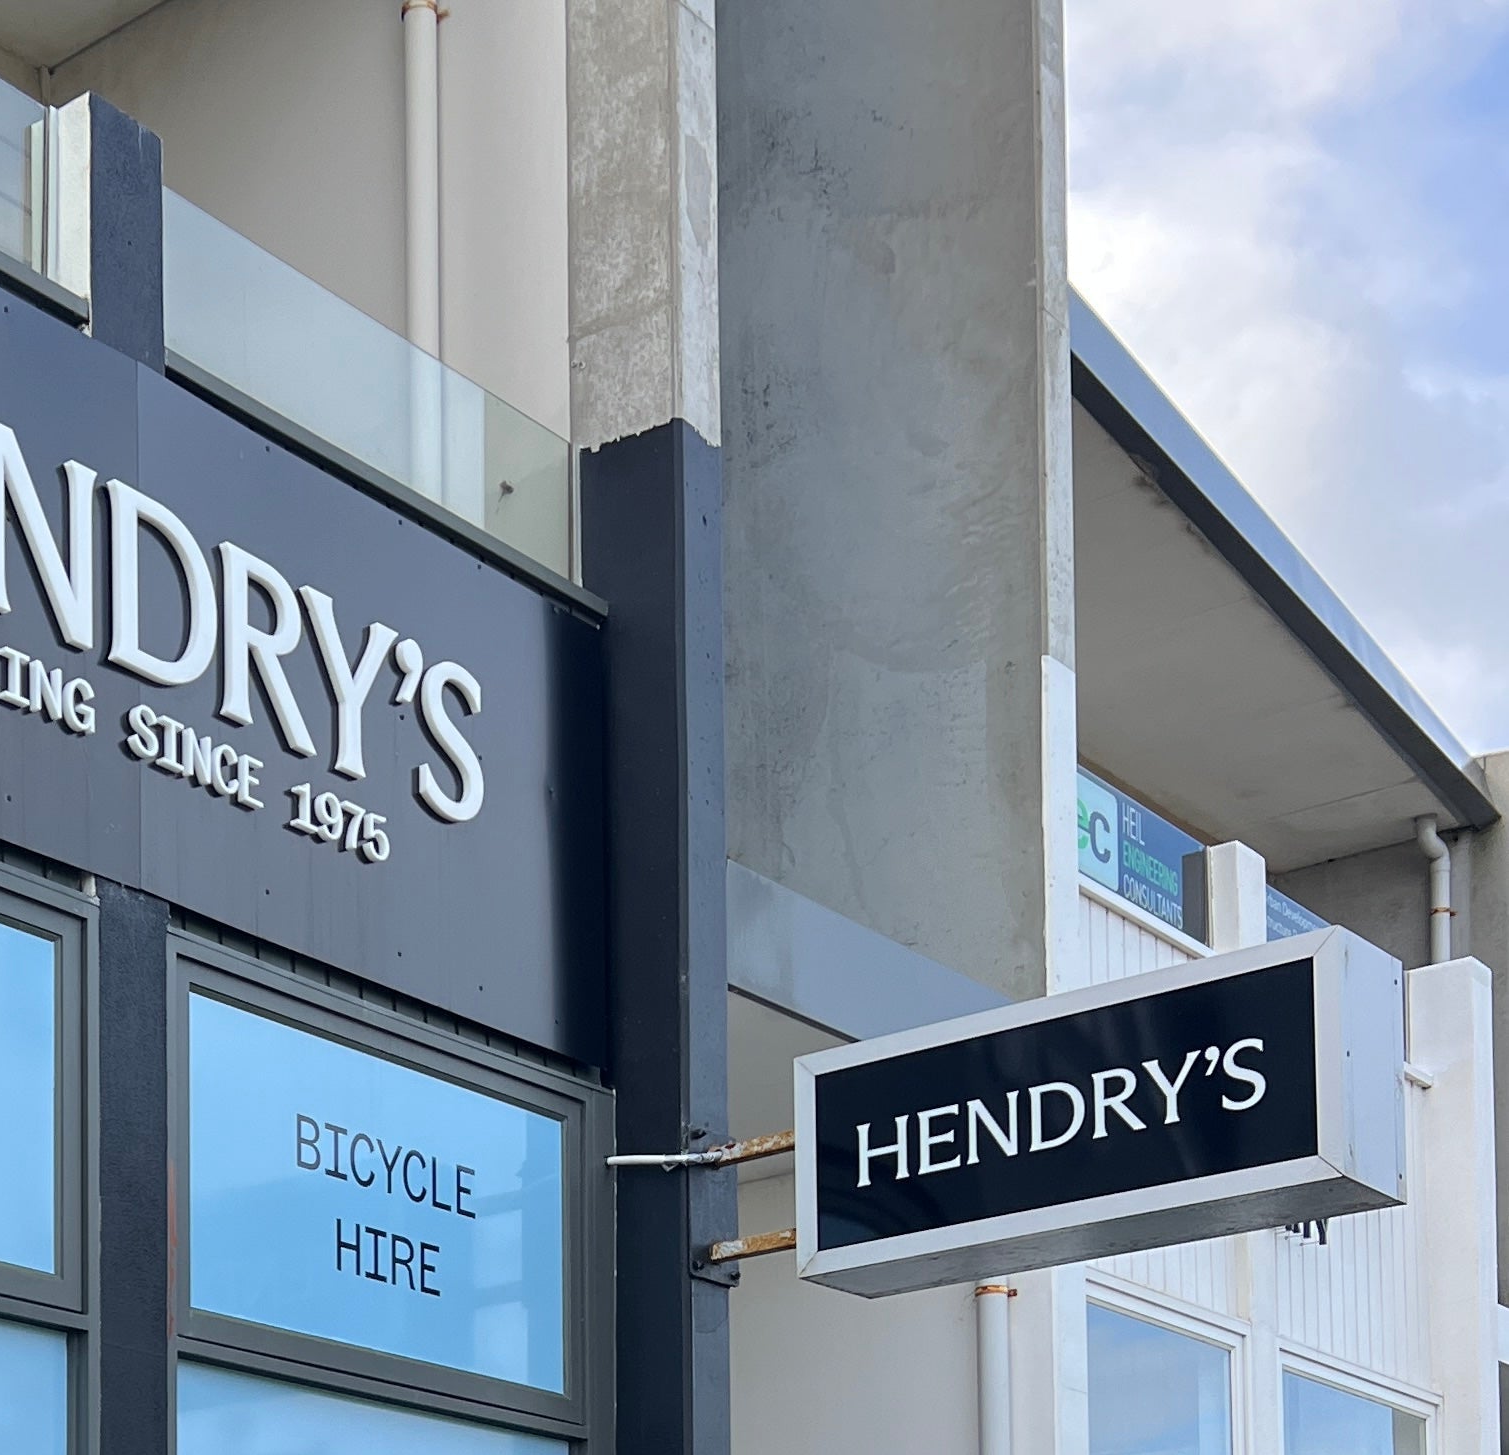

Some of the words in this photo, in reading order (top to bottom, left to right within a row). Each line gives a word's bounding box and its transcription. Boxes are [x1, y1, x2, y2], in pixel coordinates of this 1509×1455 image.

[127, 704, 264, 811] SINCE
[288, 783, 390, 863] 1975
[1122, 802, 1145, 846] HEIL
[1123, 841, 1178, 896] ENGINEERING
[1123, 874, 1183, 929] CONSULTANTS
[856, 1038, 1268, 1188] HENDRY'S
[296, 1113, 476, 1218] BICYCLE
[336, 1218, 442, 1298] HIRE
